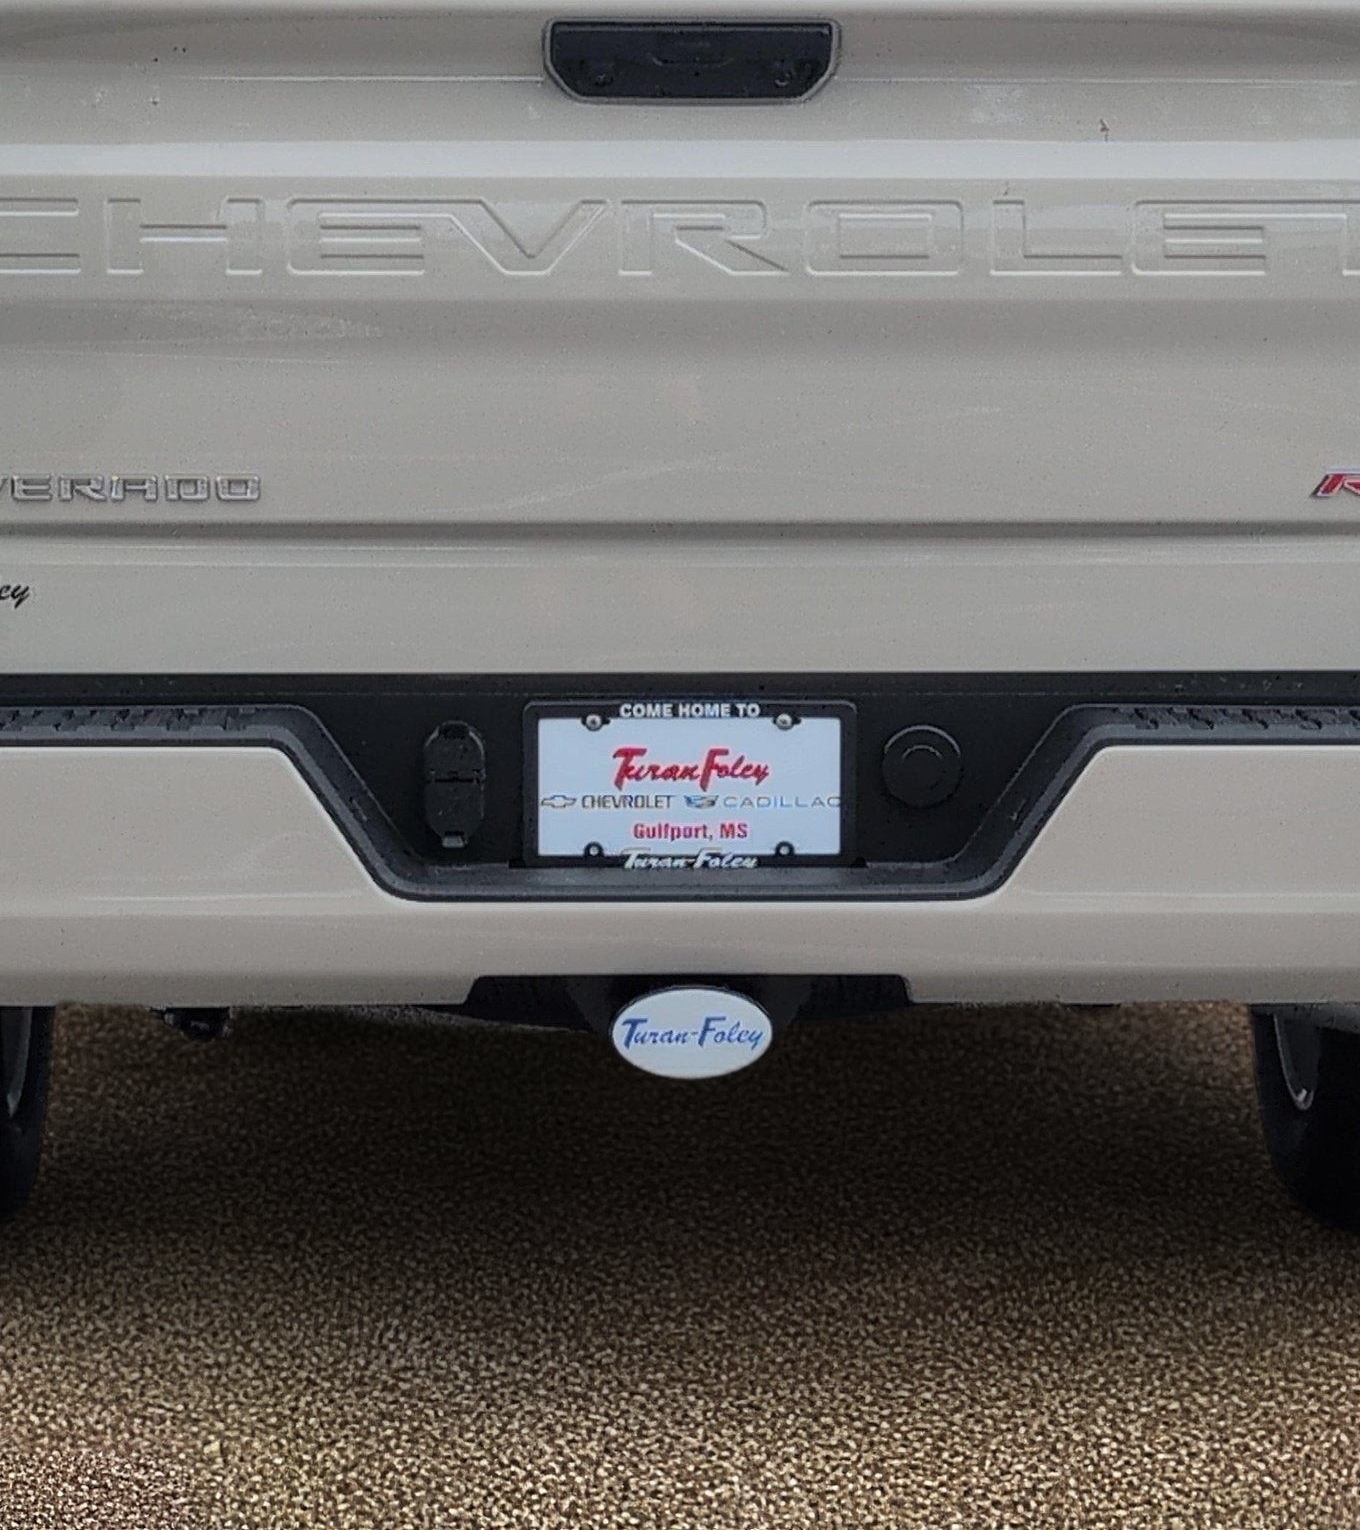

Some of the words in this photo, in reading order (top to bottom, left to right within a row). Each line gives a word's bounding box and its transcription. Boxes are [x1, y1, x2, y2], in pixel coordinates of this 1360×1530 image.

[619, 702, 673, 718] COME
[678, 702, 731, 718] HOME
[735, 702, 761, 718] TO
[581, 794, 674, 809] CHEVROLET
[723, 796, 841, 809] CADILLAC
[633, 823, 714, 841] Gulfport,
[720, 823, 749, 839] MS
[621, 1016, 764, 1050] Turan-Foley
